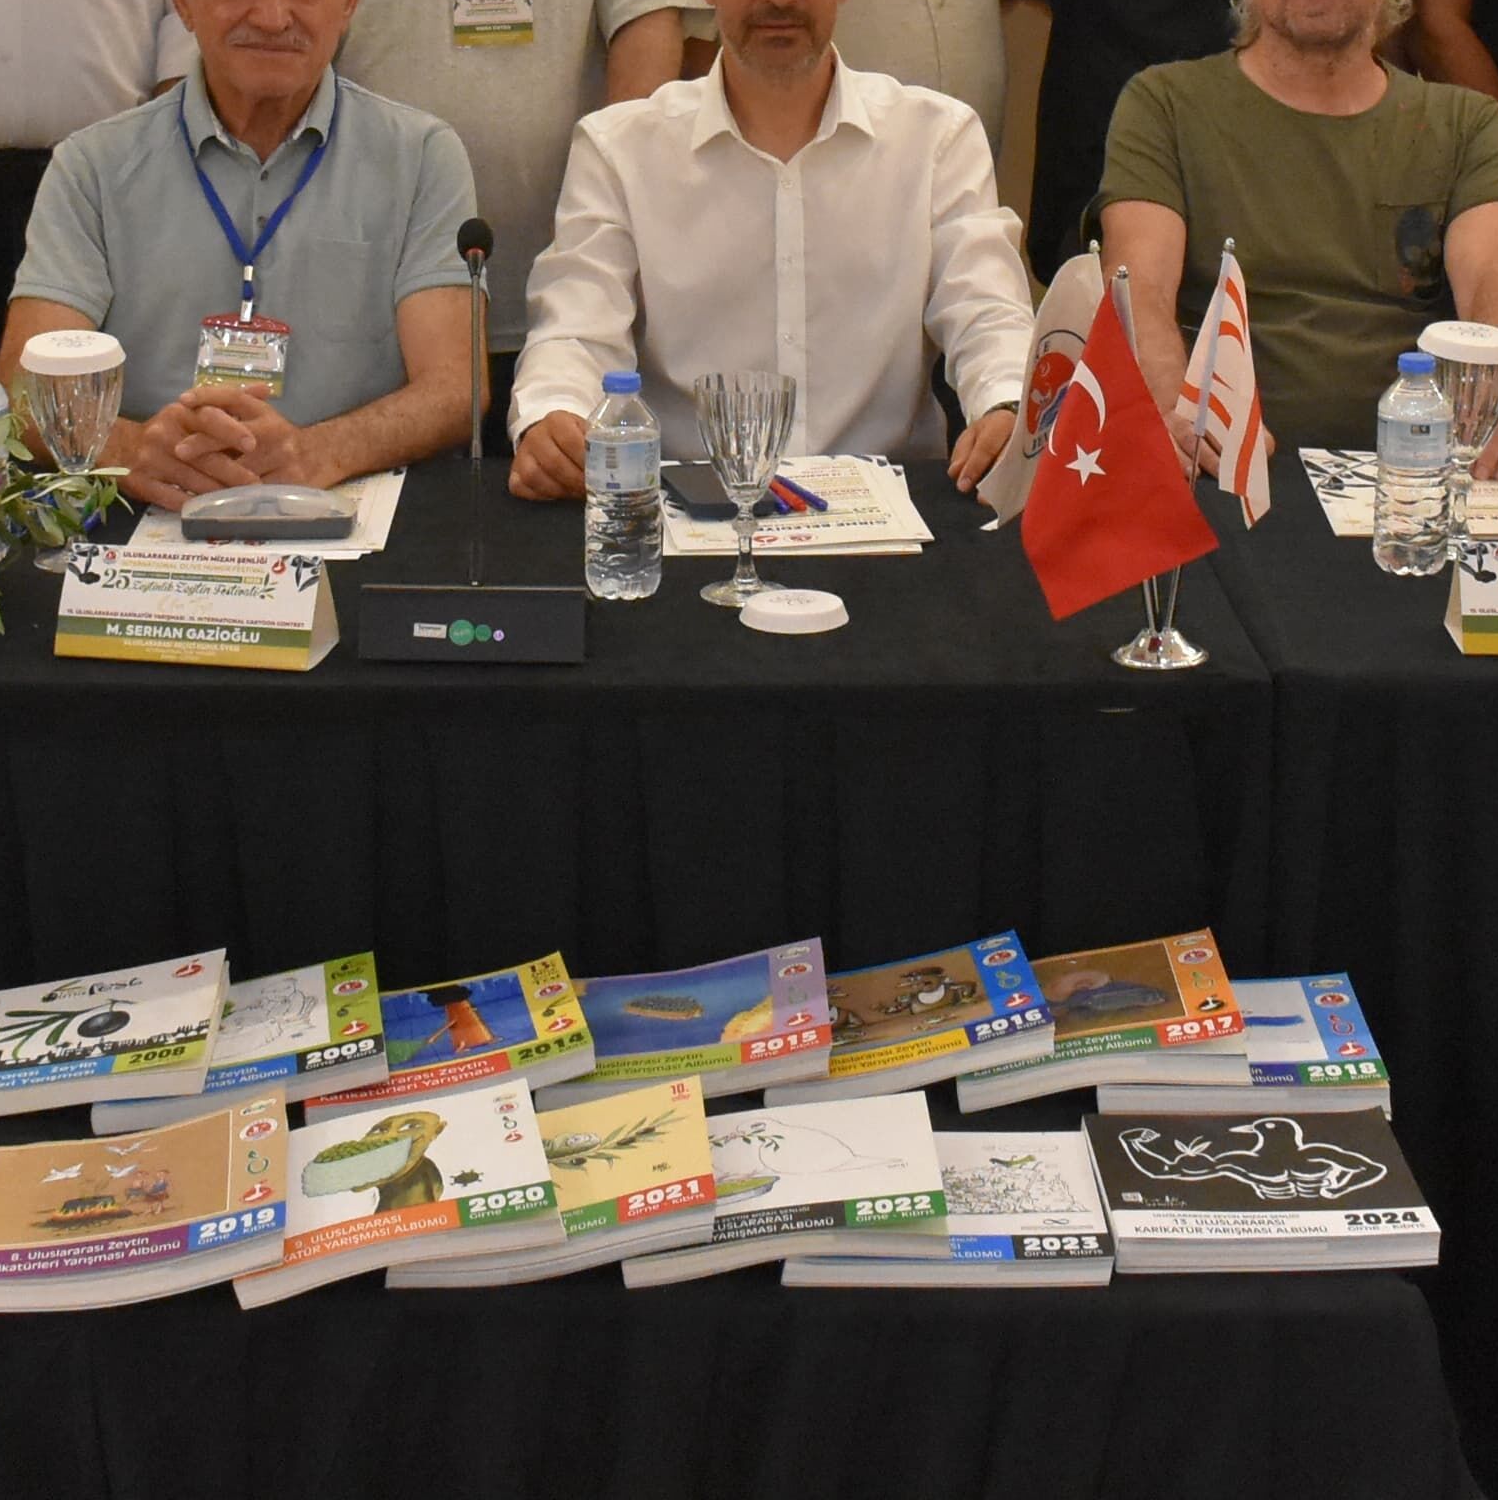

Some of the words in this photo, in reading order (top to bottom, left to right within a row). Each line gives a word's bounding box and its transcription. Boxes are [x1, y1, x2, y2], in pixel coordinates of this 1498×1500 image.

[106, 624, 122, 635] M.
[125, 624, 184, 638] SERHAN
[186, 626, 260, 643] GAZİOĞLU
[975, 1008, 1043, 1037] 2016
[1165, 1015, 1234, 1036] 2017
[517, 1032, 586, 1060] 2014
[750, 1030, 818, 1055] 2015
[1085, 1033, 1123, 1046] Zeytin
[1106, 1037, 1152, 1051] Albümü
[129, 1046, 187, 1064] 2008
[305, 1038, 376, 1066] 2009
[439, 1059, 488, 1076] Zeytin
[1307, 1062, 1378, 1078] 2018
[421, 1066, 496, 1091] Yarışması
[468, 1185, 547, 1213] 2020
[627, 1179, 701, 1211] 2021
[468, 1208, 502, 1220] Girne
[627, 1202, 661, 1217] Girne
[855, 1195, 932, 1216] 2022
[198, 1207, 276, 1238] 2019
[780, 1217, 835, 1231] ALBÜMÜ
[855, 1212, 889, 1222] Girne
[1195, 1218, 1286, 1227] ULUSLARARASI
[1343, 1211, 1421, 1226] 2024
[311, 1214, 403, 1246] ULUSLARARASI
[323, 1227, 391, 1252] YARIŞMASI
[394, 1214, 449, 1234] ALBÜMÜ
[1134, 1225, 1204, 1235] KARİKATÜR
[1206, 1225, 1273, 1236] YARIŞMASI
[1276, 1225, 1329, 1234] ALBÜMÜ
[10, 1252, 22, 1262] 8.
[28, 1243, 106, 1262] Uluslararası
[109, 1236, 150, 1251] Zeytin
[63, 1250, 125, 1268] Yarışması
[128, 1239, 182, 1256] Albümü
[1023, 1236, 1100, 1252] 2023
